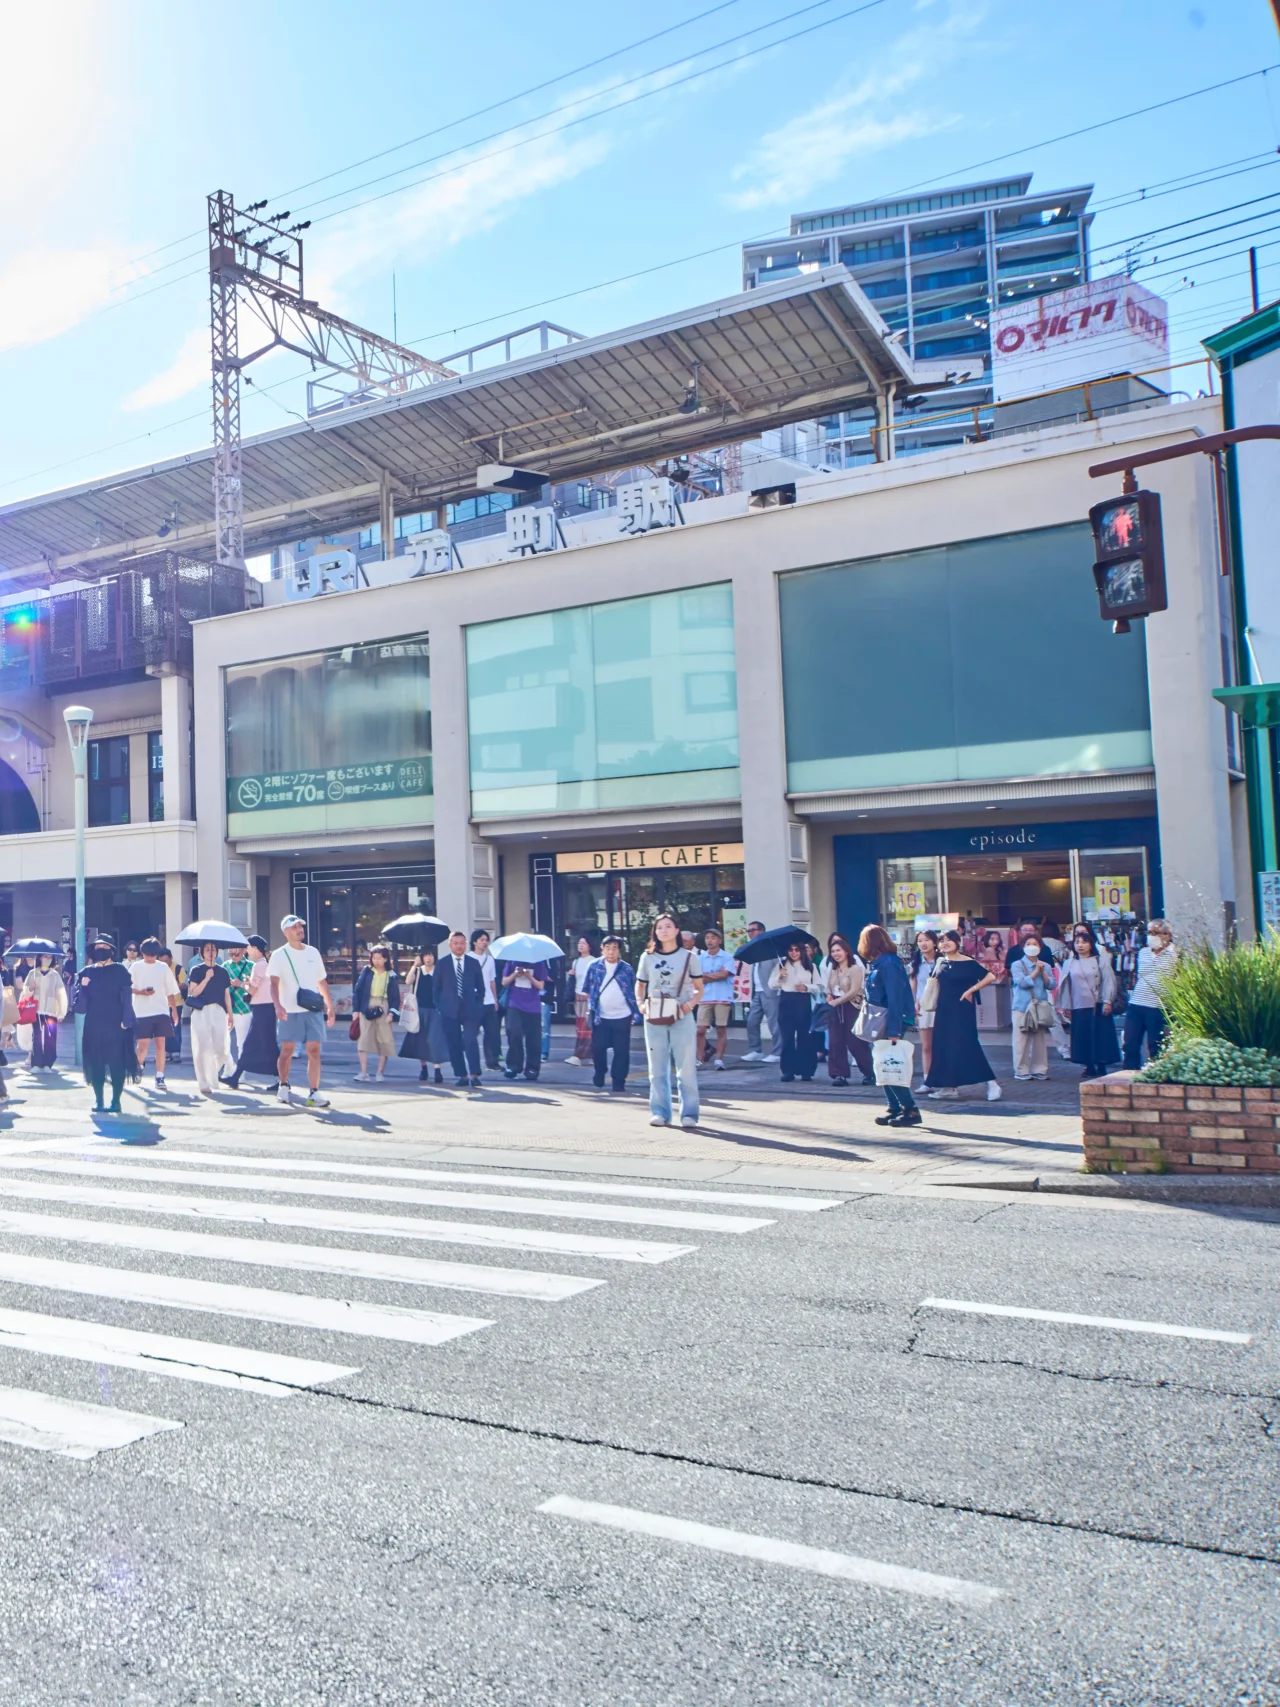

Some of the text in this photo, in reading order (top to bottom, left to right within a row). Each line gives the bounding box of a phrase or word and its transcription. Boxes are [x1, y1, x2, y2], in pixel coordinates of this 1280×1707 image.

[400, 766, 422, 776] DELI
[400, 778, 423, 788] CAFE
[969, 829, 1036, 850] episode
[593, 846, 719, 869] DELI CAFE
